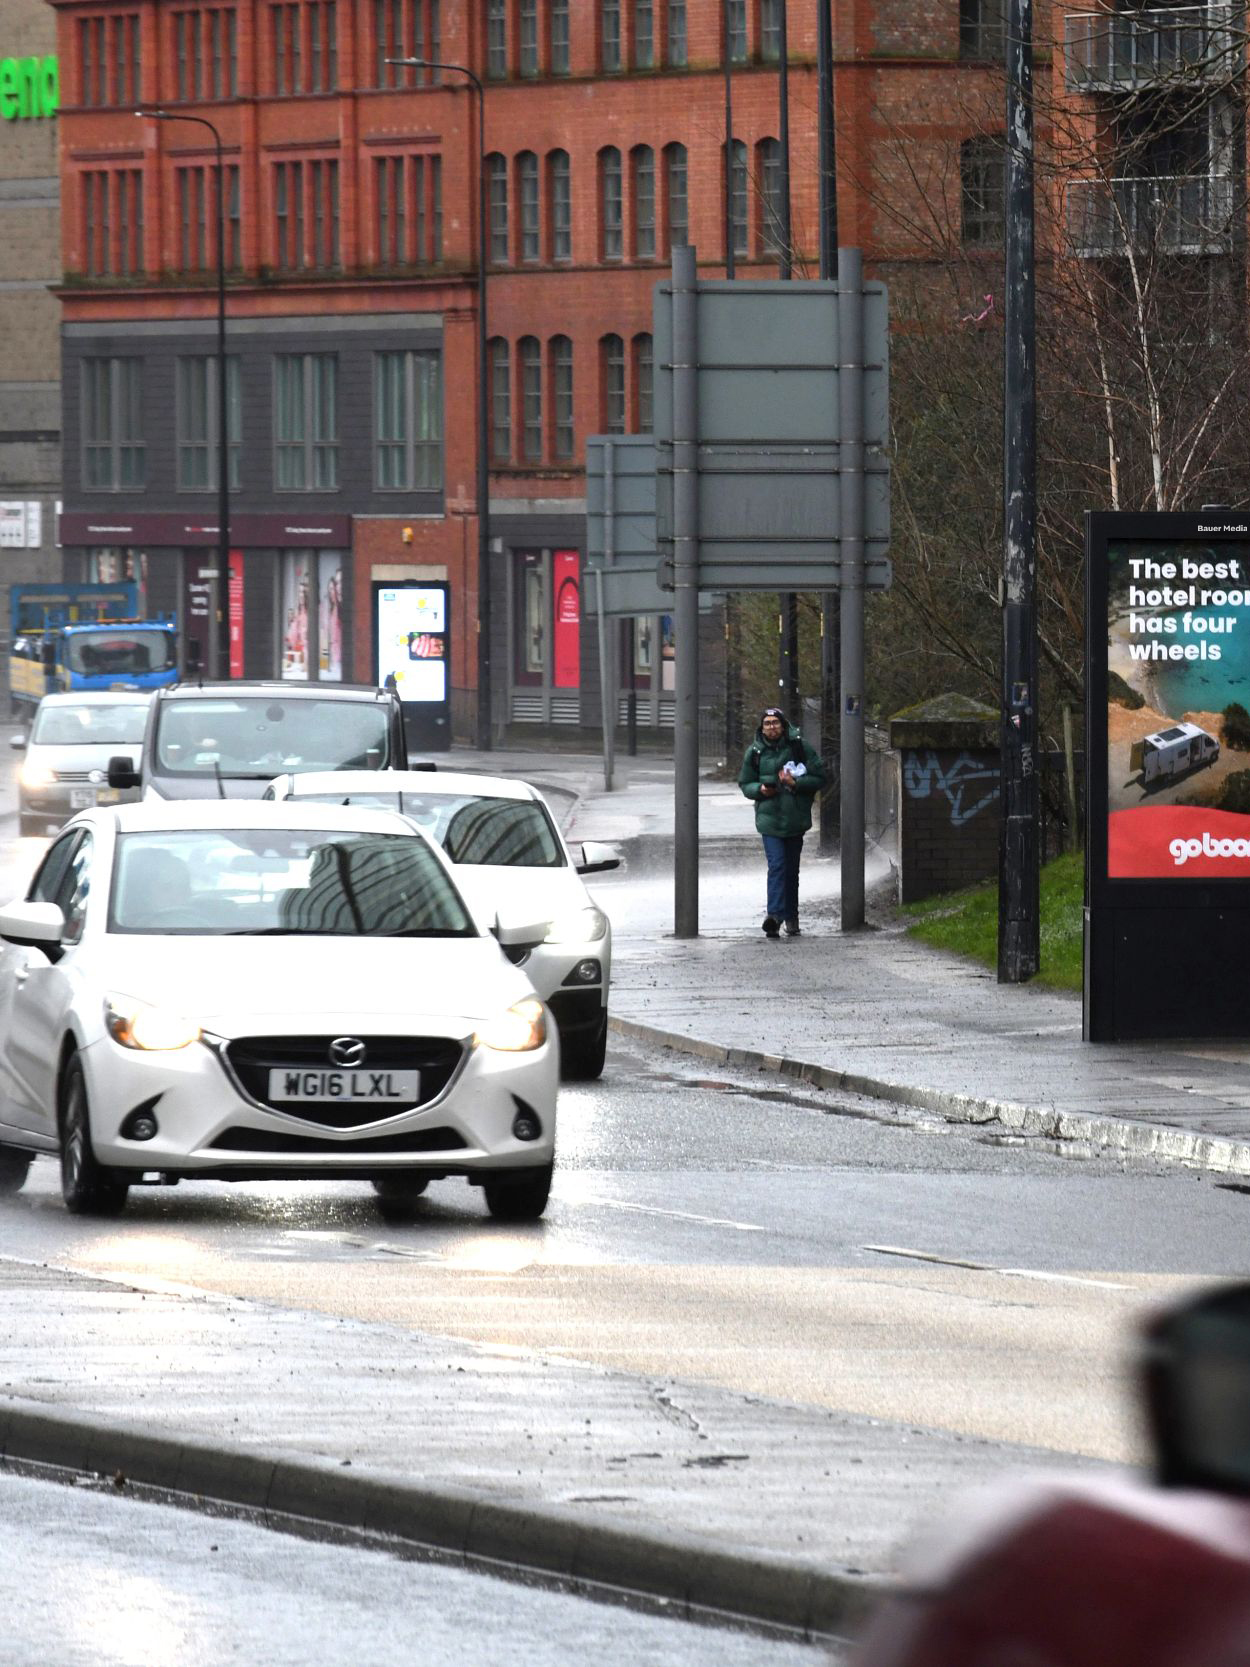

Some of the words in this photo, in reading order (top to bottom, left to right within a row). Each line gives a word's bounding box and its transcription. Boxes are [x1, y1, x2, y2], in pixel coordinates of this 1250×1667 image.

[1197, 524, 1222, 532] Bauer
[1223, 524, 1248, 532] Media
[1128, 558, 1177, 579] The
[1182, 558, 1239, 579] best
[1129, 585, 1196, 606] hotel
[1129, 613, 1177, 633] has
[1182, 612, 1237, 633] four
[1128, 640, 1222, 661] wheels
[285, 1073, 343, 1096] WG16
[351, 1073, 401, 1097] LXL
